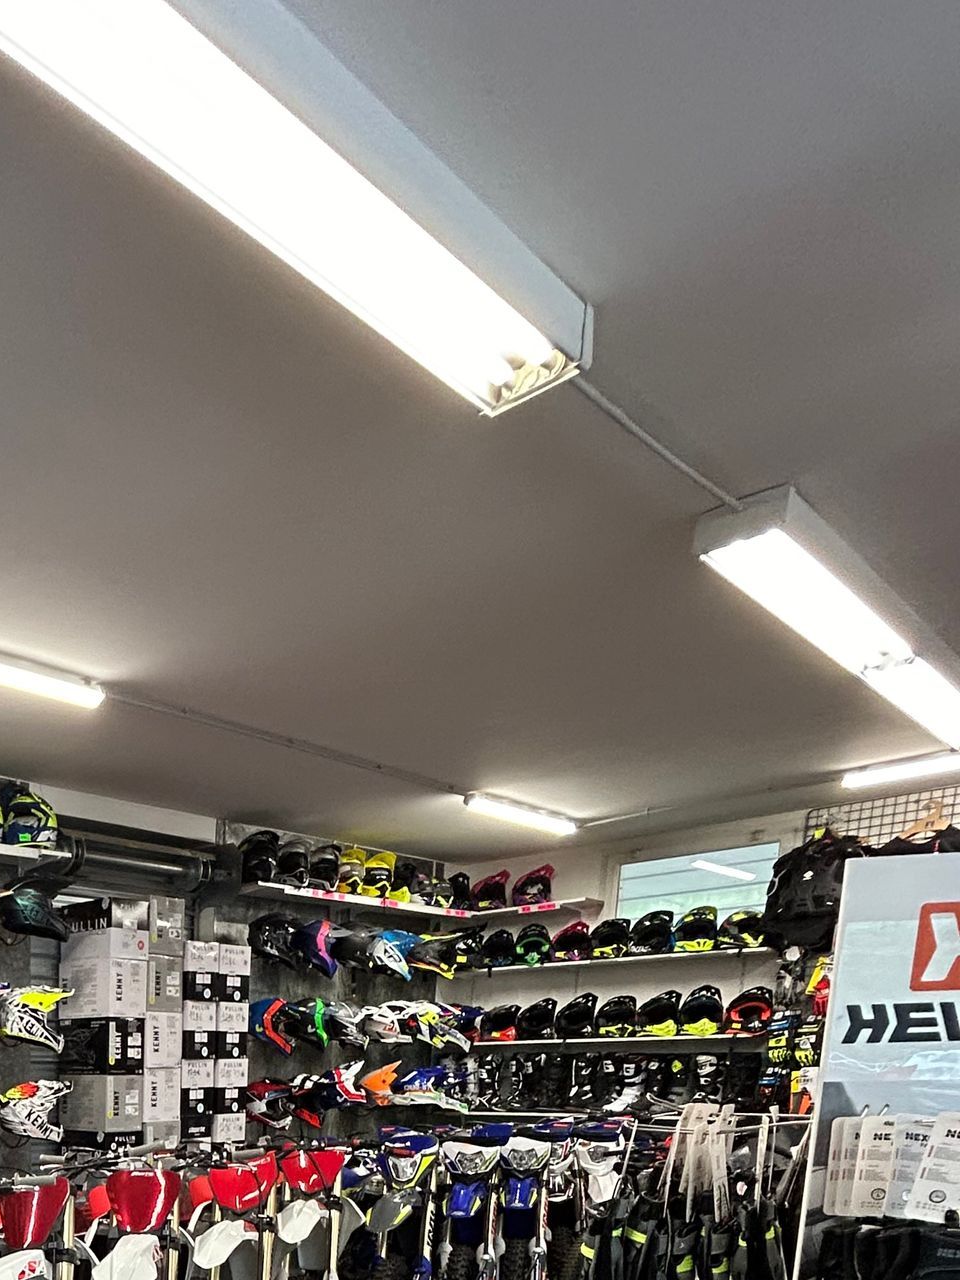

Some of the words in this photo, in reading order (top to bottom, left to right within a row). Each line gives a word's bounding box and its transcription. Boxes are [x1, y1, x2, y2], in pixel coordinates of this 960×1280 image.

[72, 917, 108, 933] ULLIN
[114, 1032, 122, 1060] KENNY
[152, 1025, 160, 1053] KENNY
